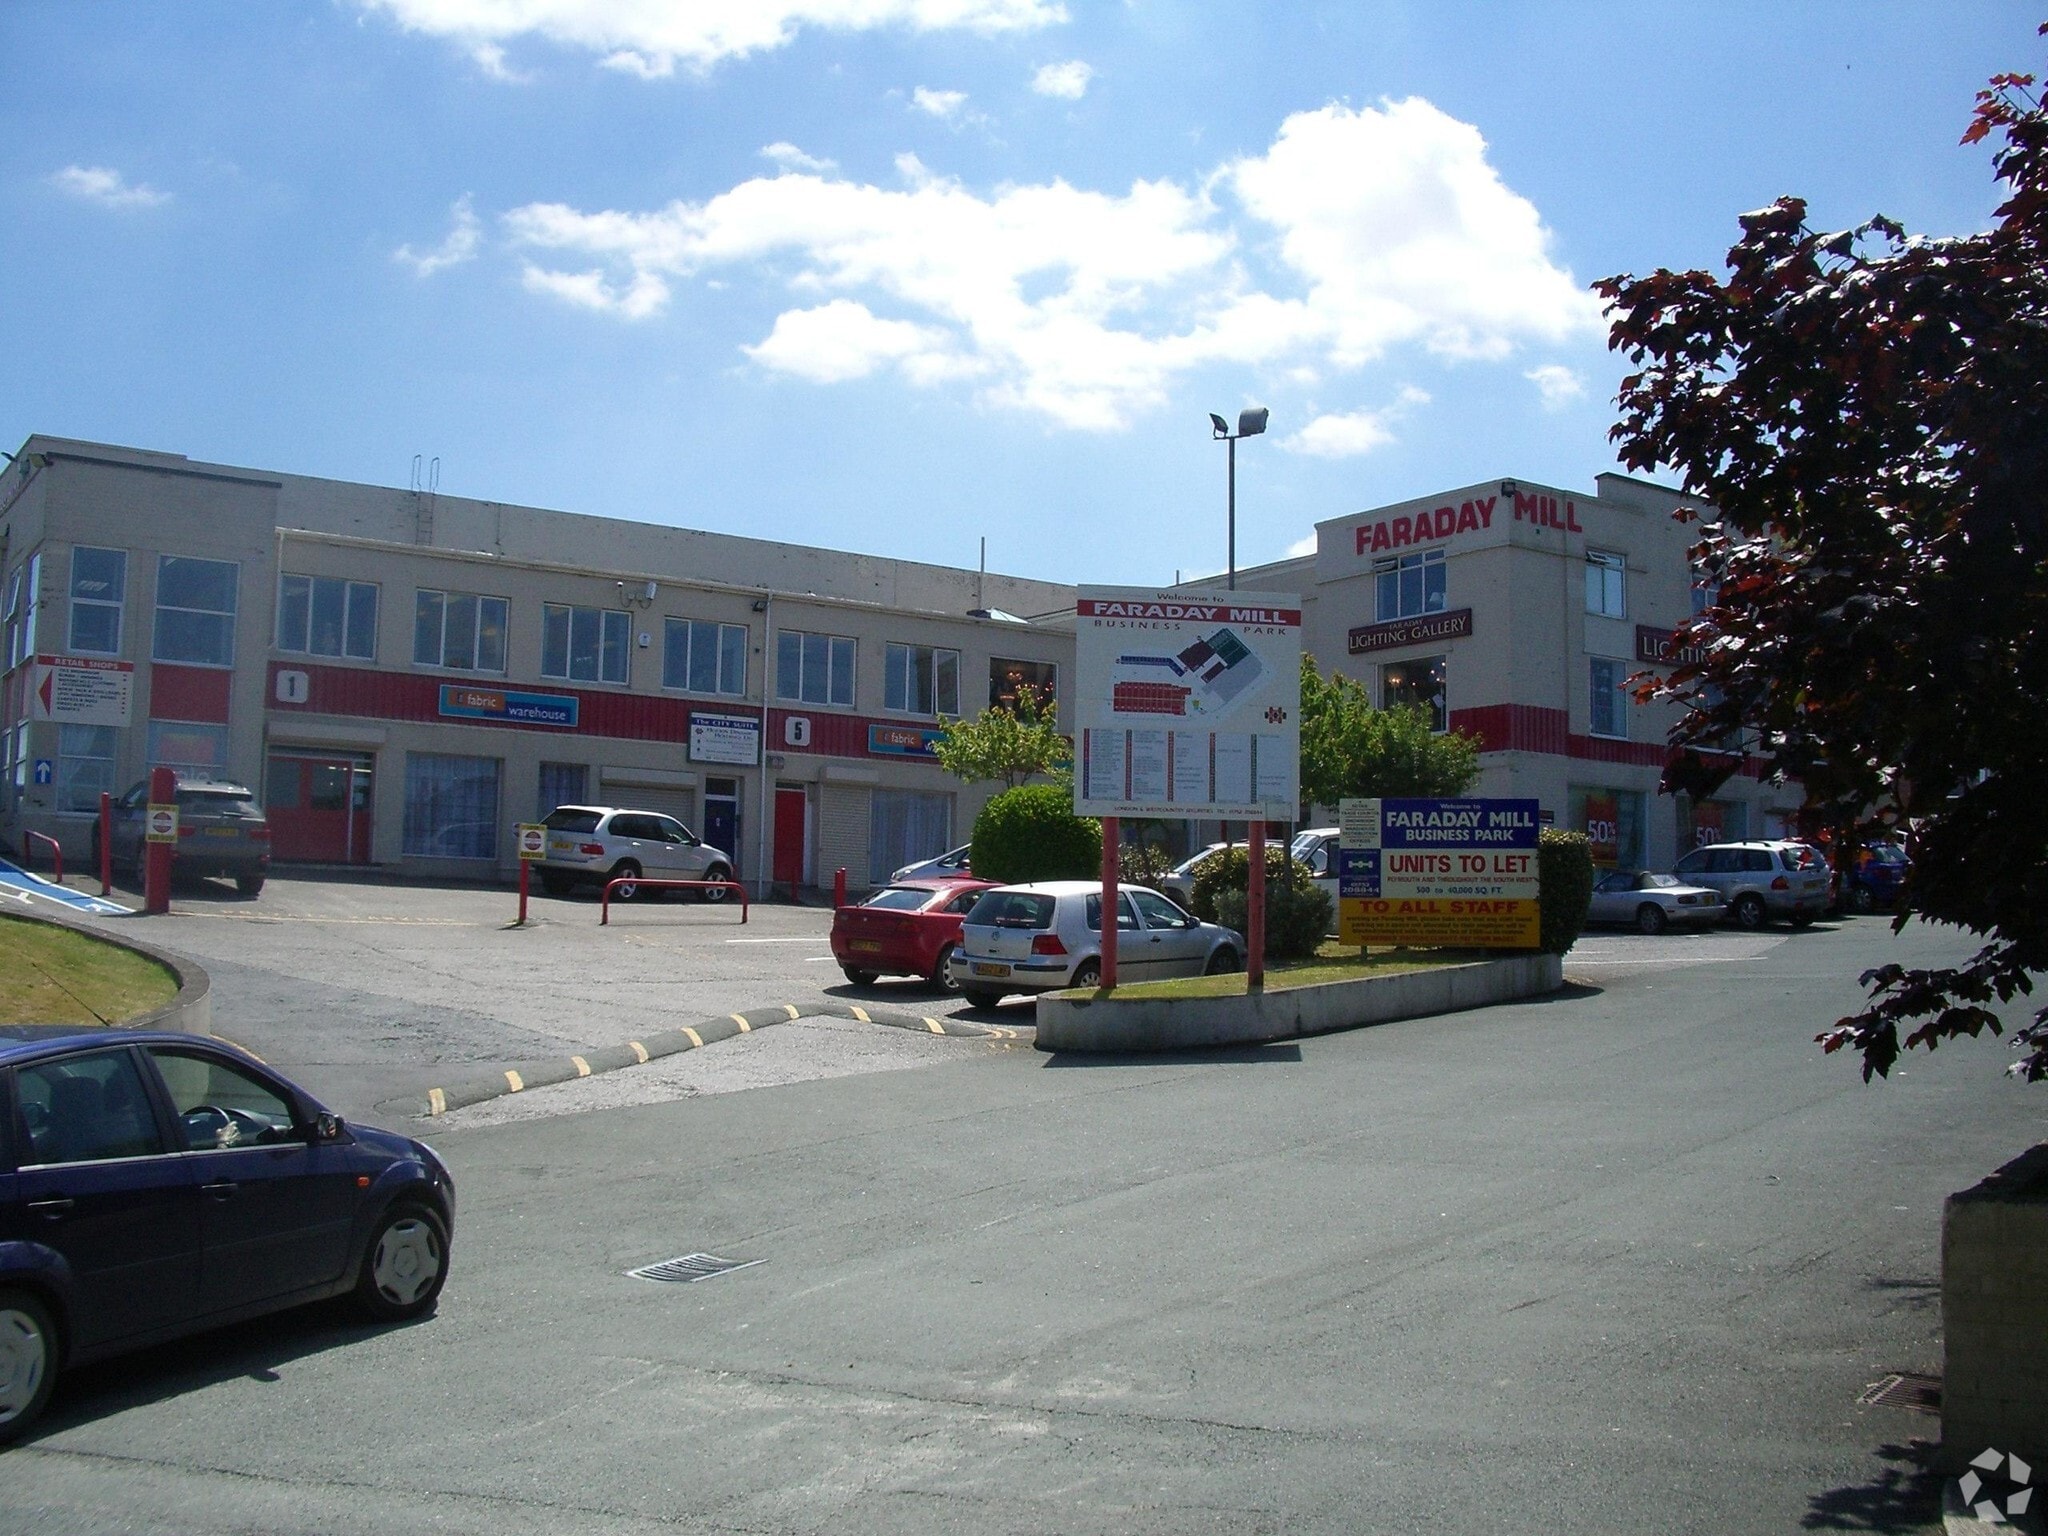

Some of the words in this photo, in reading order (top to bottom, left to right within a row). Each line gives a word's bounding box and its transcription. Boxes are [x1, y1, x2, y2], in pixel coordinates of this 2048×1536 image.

[1356, 496, 1497, 556] FARADAY
[1514, 491, 1583, 533] MILL
[1157, 592, 1208, 601] Welcome
[1094, 602, 1217, 620] FARADAY
[1230, 608, 1287, 623] MILL
[1094, 620, 1181, 630] BUSINESS
[1243, 626, 1286, 635] PARK
[1389, 618, 1424, 631] FARADAY
[1350, 629, 1407, 650] LIGHTING
[1411, 616, 1467, 640] GALLERY
[54, 658, 85, 667] RETAIL
[89, 661, 118, 670] SHOPS
[287, 676, 295, 697] 1
[467, 693, 497, 707] fabric
[508, 706, 566, 721] warehouse
[794, 722, 802, 740] 5
[891, 732, 915, 745] fabric
[1386, 811, 1482, 827] FARADAY
[1489, 812, 1534, 827] MILL
[1406, 830, 1470, 841] BUSINESS
[1475, 830, 1514, 841] PARK
[1587, 820, 1616, 844] 50%
[1389, 855, 1451, 873] UNITS
[1458, 855, 1486, 873] TO
[1494, 855, 1530, 873] LET
[1359, 901, 1390, 914] TO
[1399, 901, 1441, 914] ALL
[1450, 901, 1519, 914] STAFF
